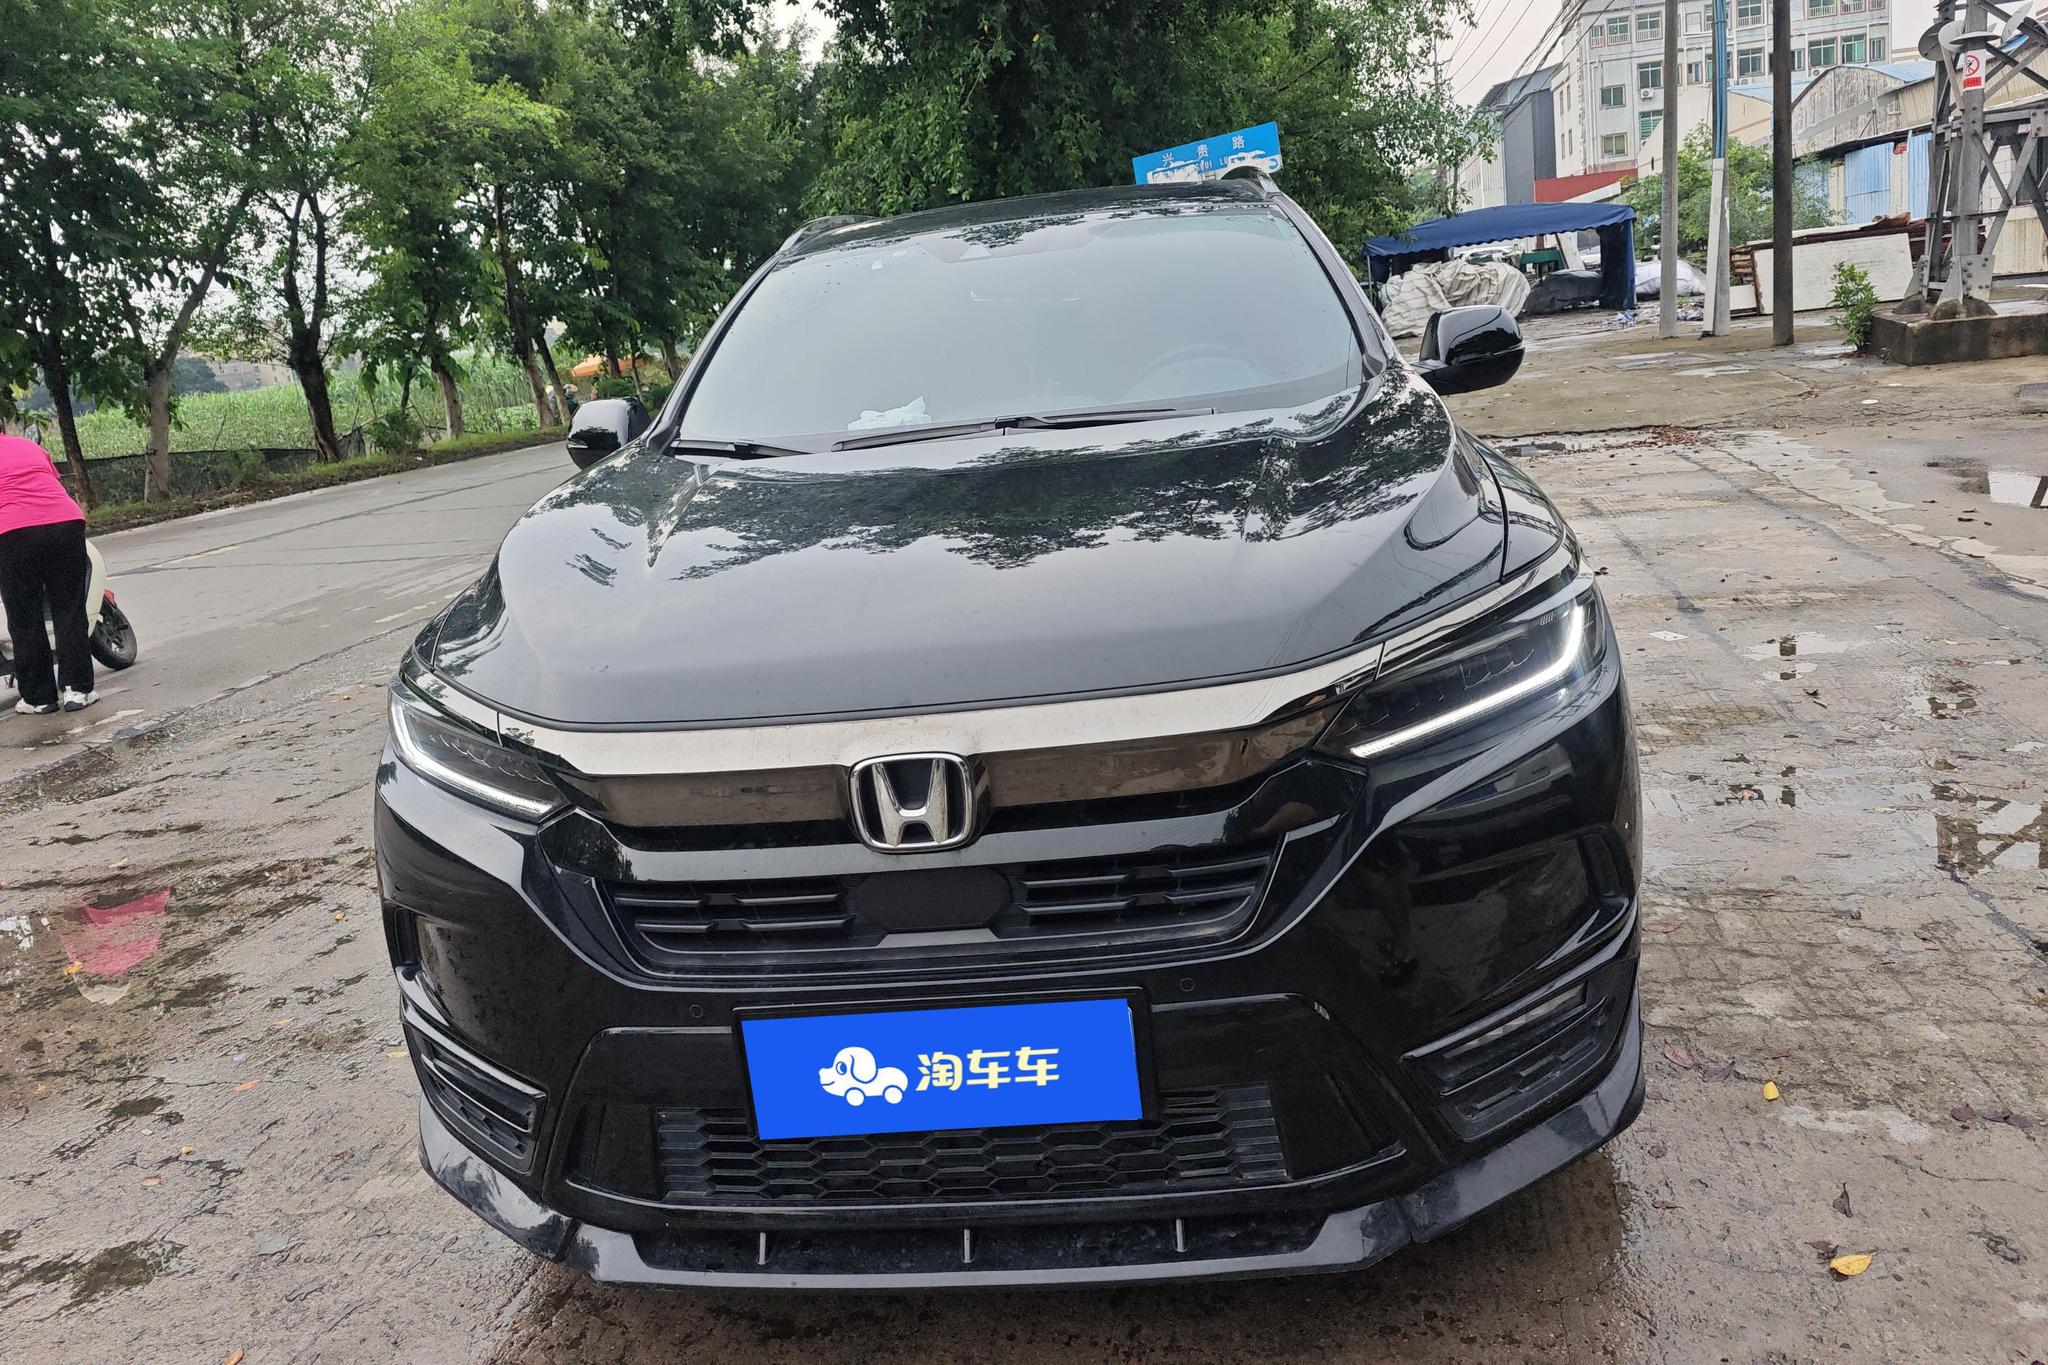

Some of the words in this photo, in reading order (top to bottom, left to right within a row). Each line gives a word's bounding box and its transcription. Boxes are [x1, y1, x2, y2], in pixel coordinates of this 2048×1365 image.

[1162, 135, 1245, 167] 兴贵路
[872, 758, 948, 847] H
